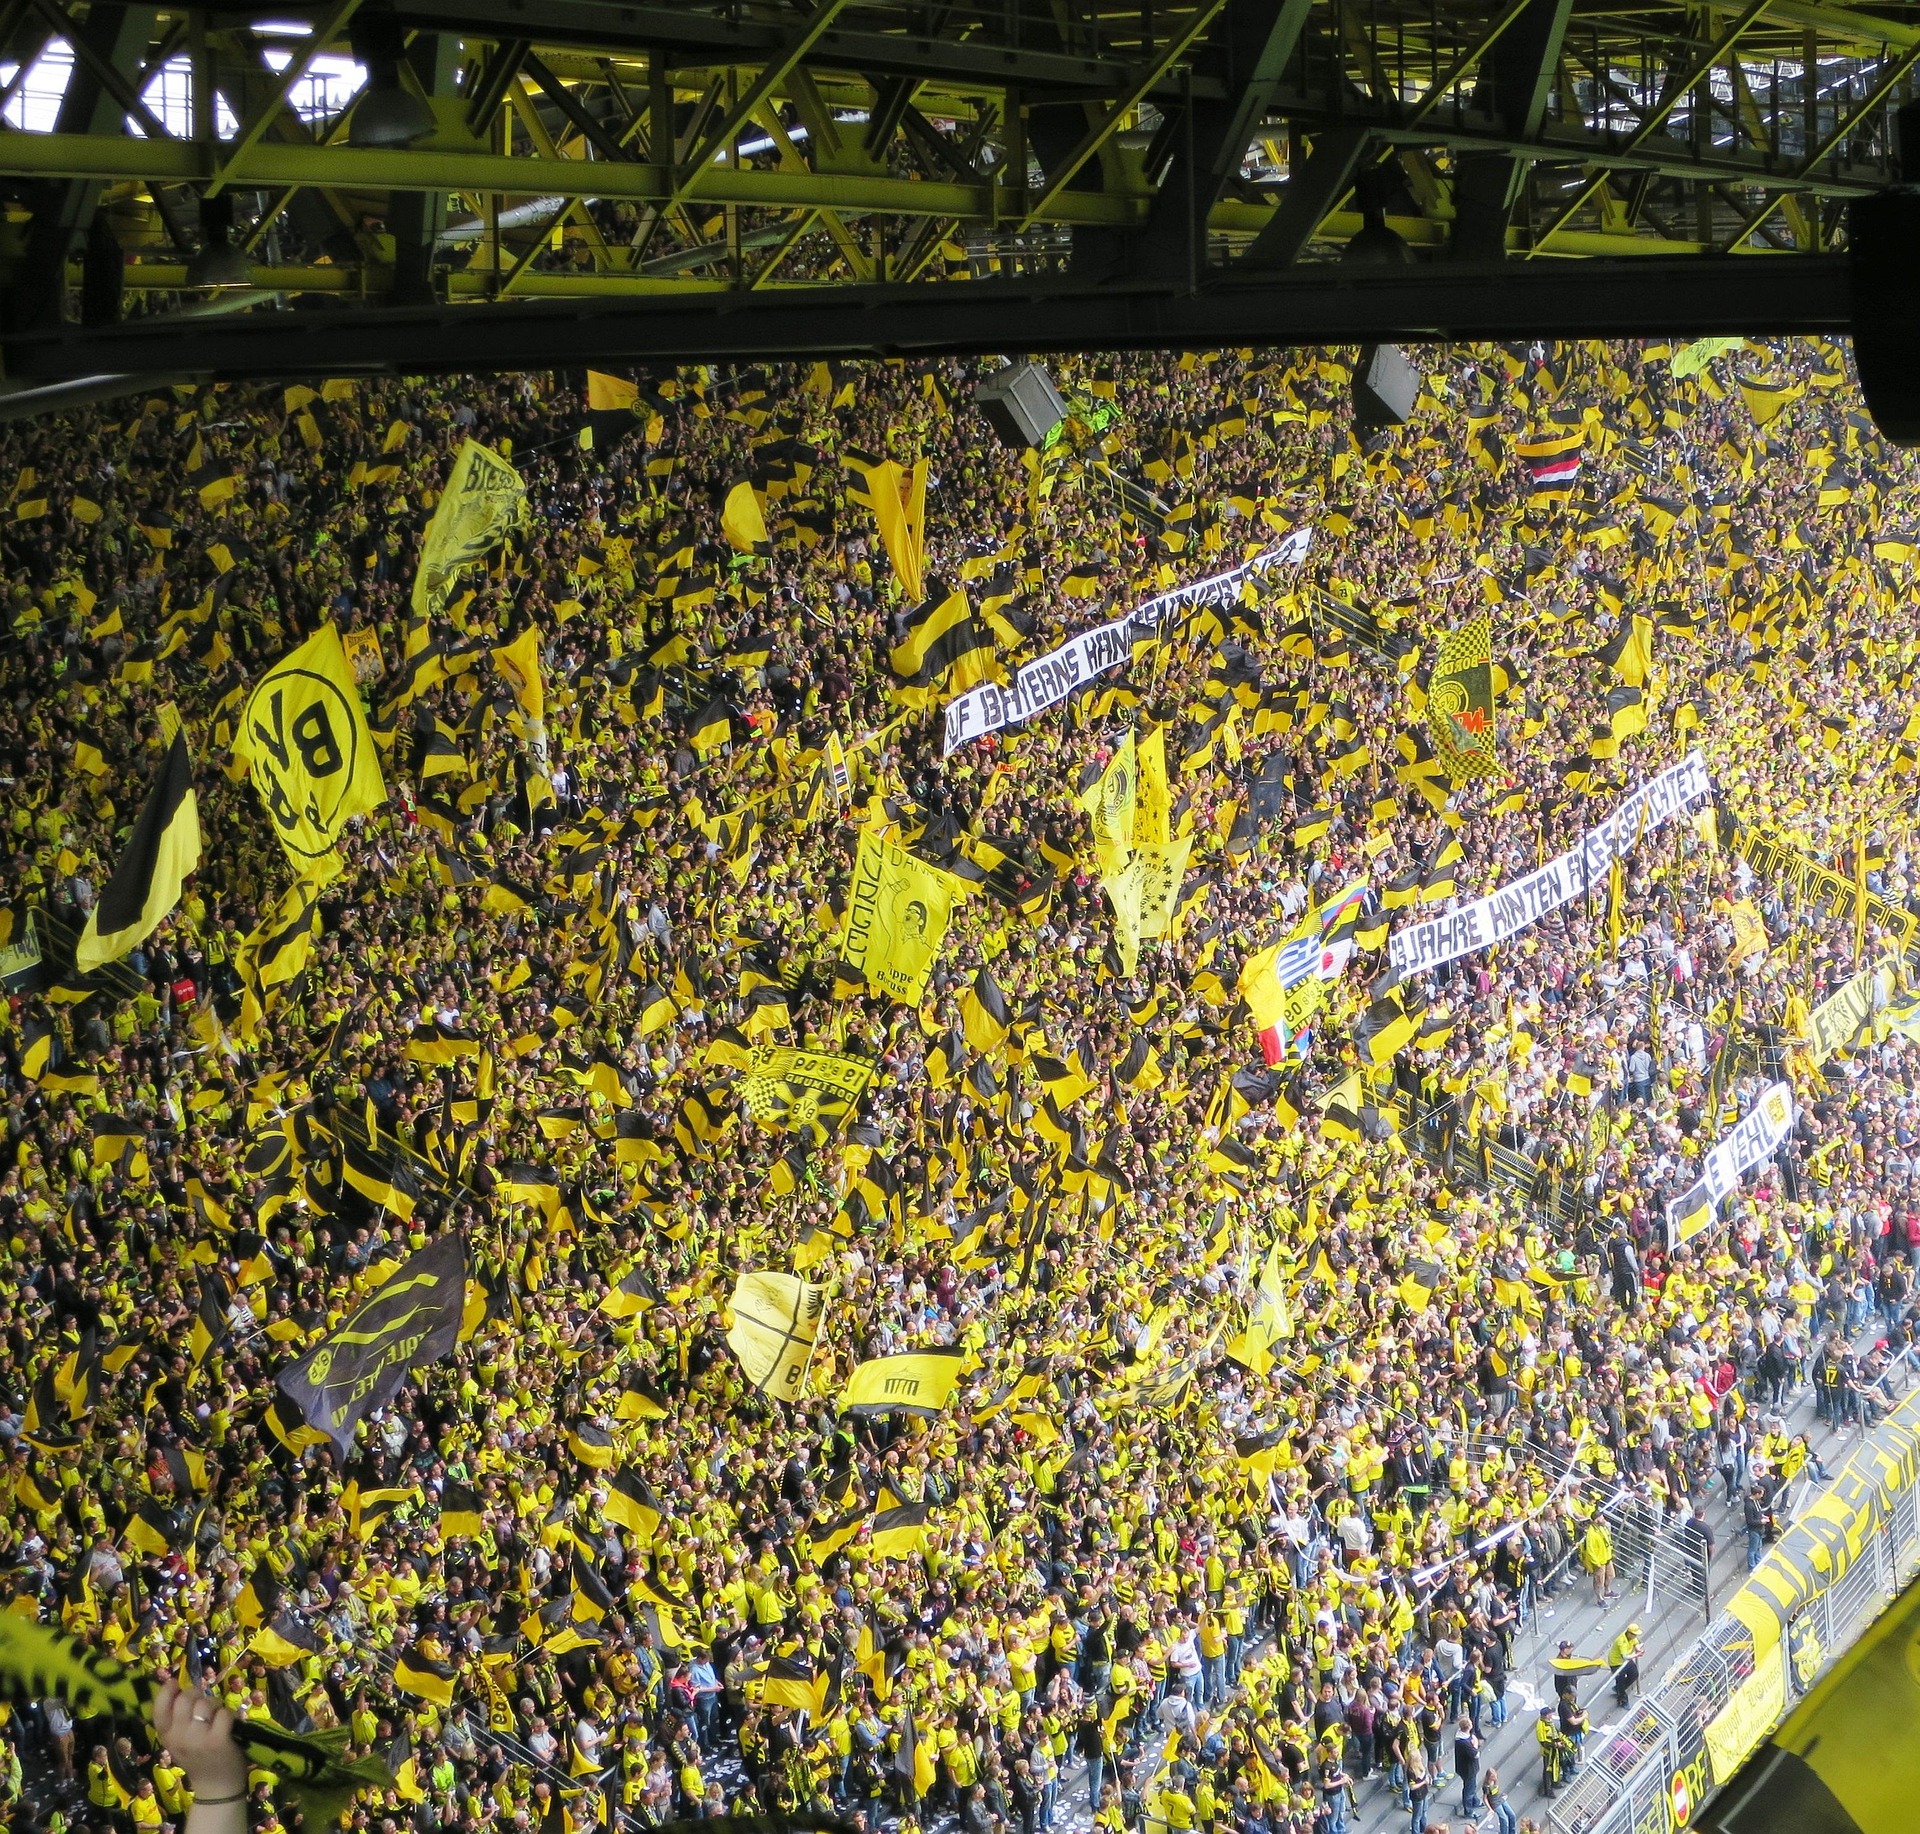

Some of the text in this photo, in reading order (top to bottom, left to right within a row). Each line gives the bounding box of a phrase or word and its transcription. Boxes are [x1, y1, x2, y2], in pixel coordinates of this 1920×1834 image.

[980, 648, 1079, 726] BAYERNS
[1409, 909, 1482, 969] JAHRE
[1488, 866, 1563, 936] HINTEN
[1566, 825, 1617, 890] ALES
[1826, 1370, 1838, 1384] 17
